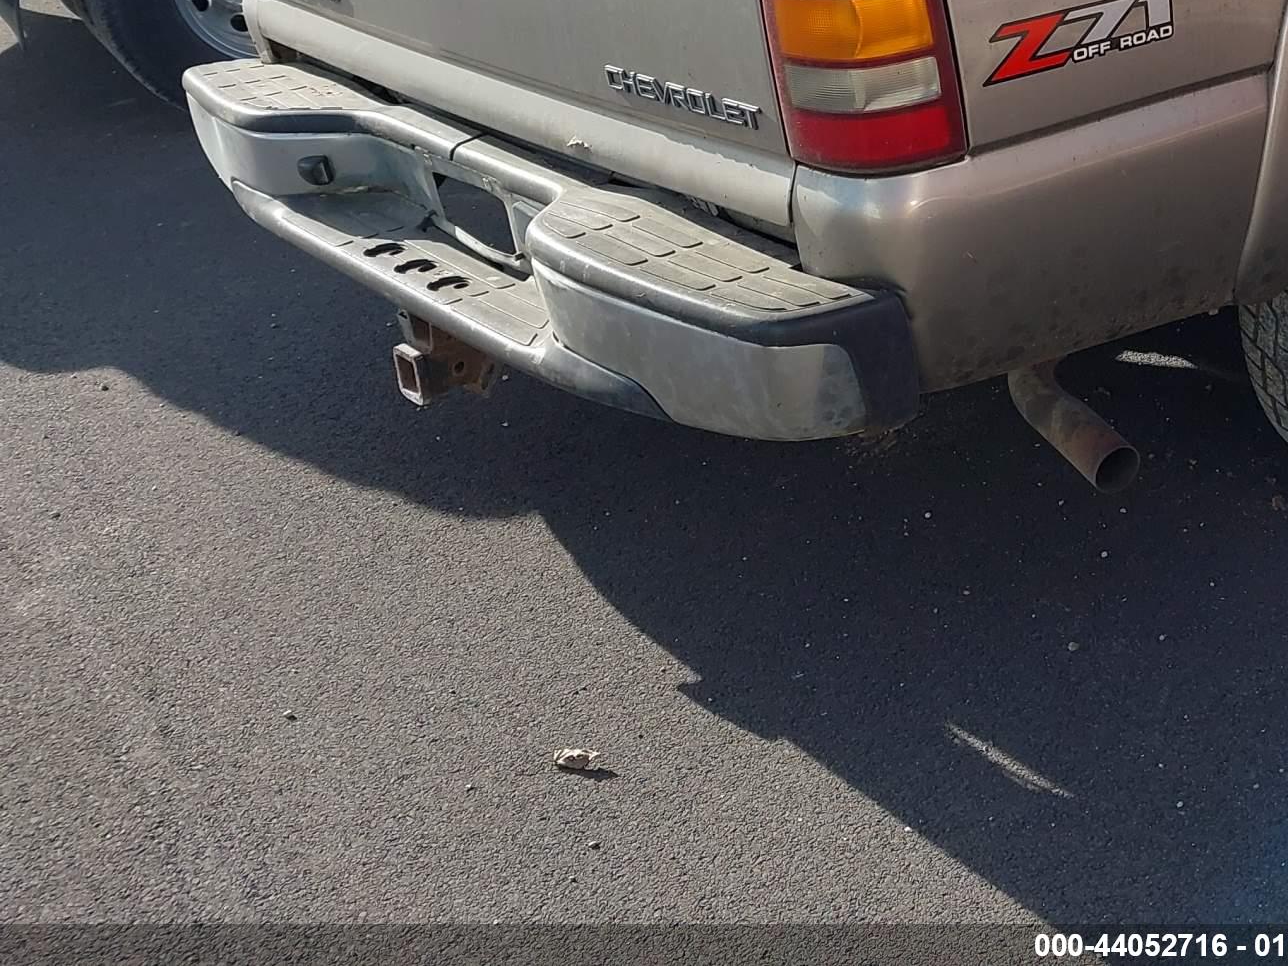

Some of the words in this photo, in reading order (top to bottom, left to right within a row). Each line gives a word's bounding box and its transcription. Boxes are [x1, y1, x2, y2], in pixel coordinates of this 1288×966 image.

[1073, 40, 1111, 62] OFF
[1120, 25, 1173, 50] ROAD
[604, 64, 763, 130] CHEVROLET
